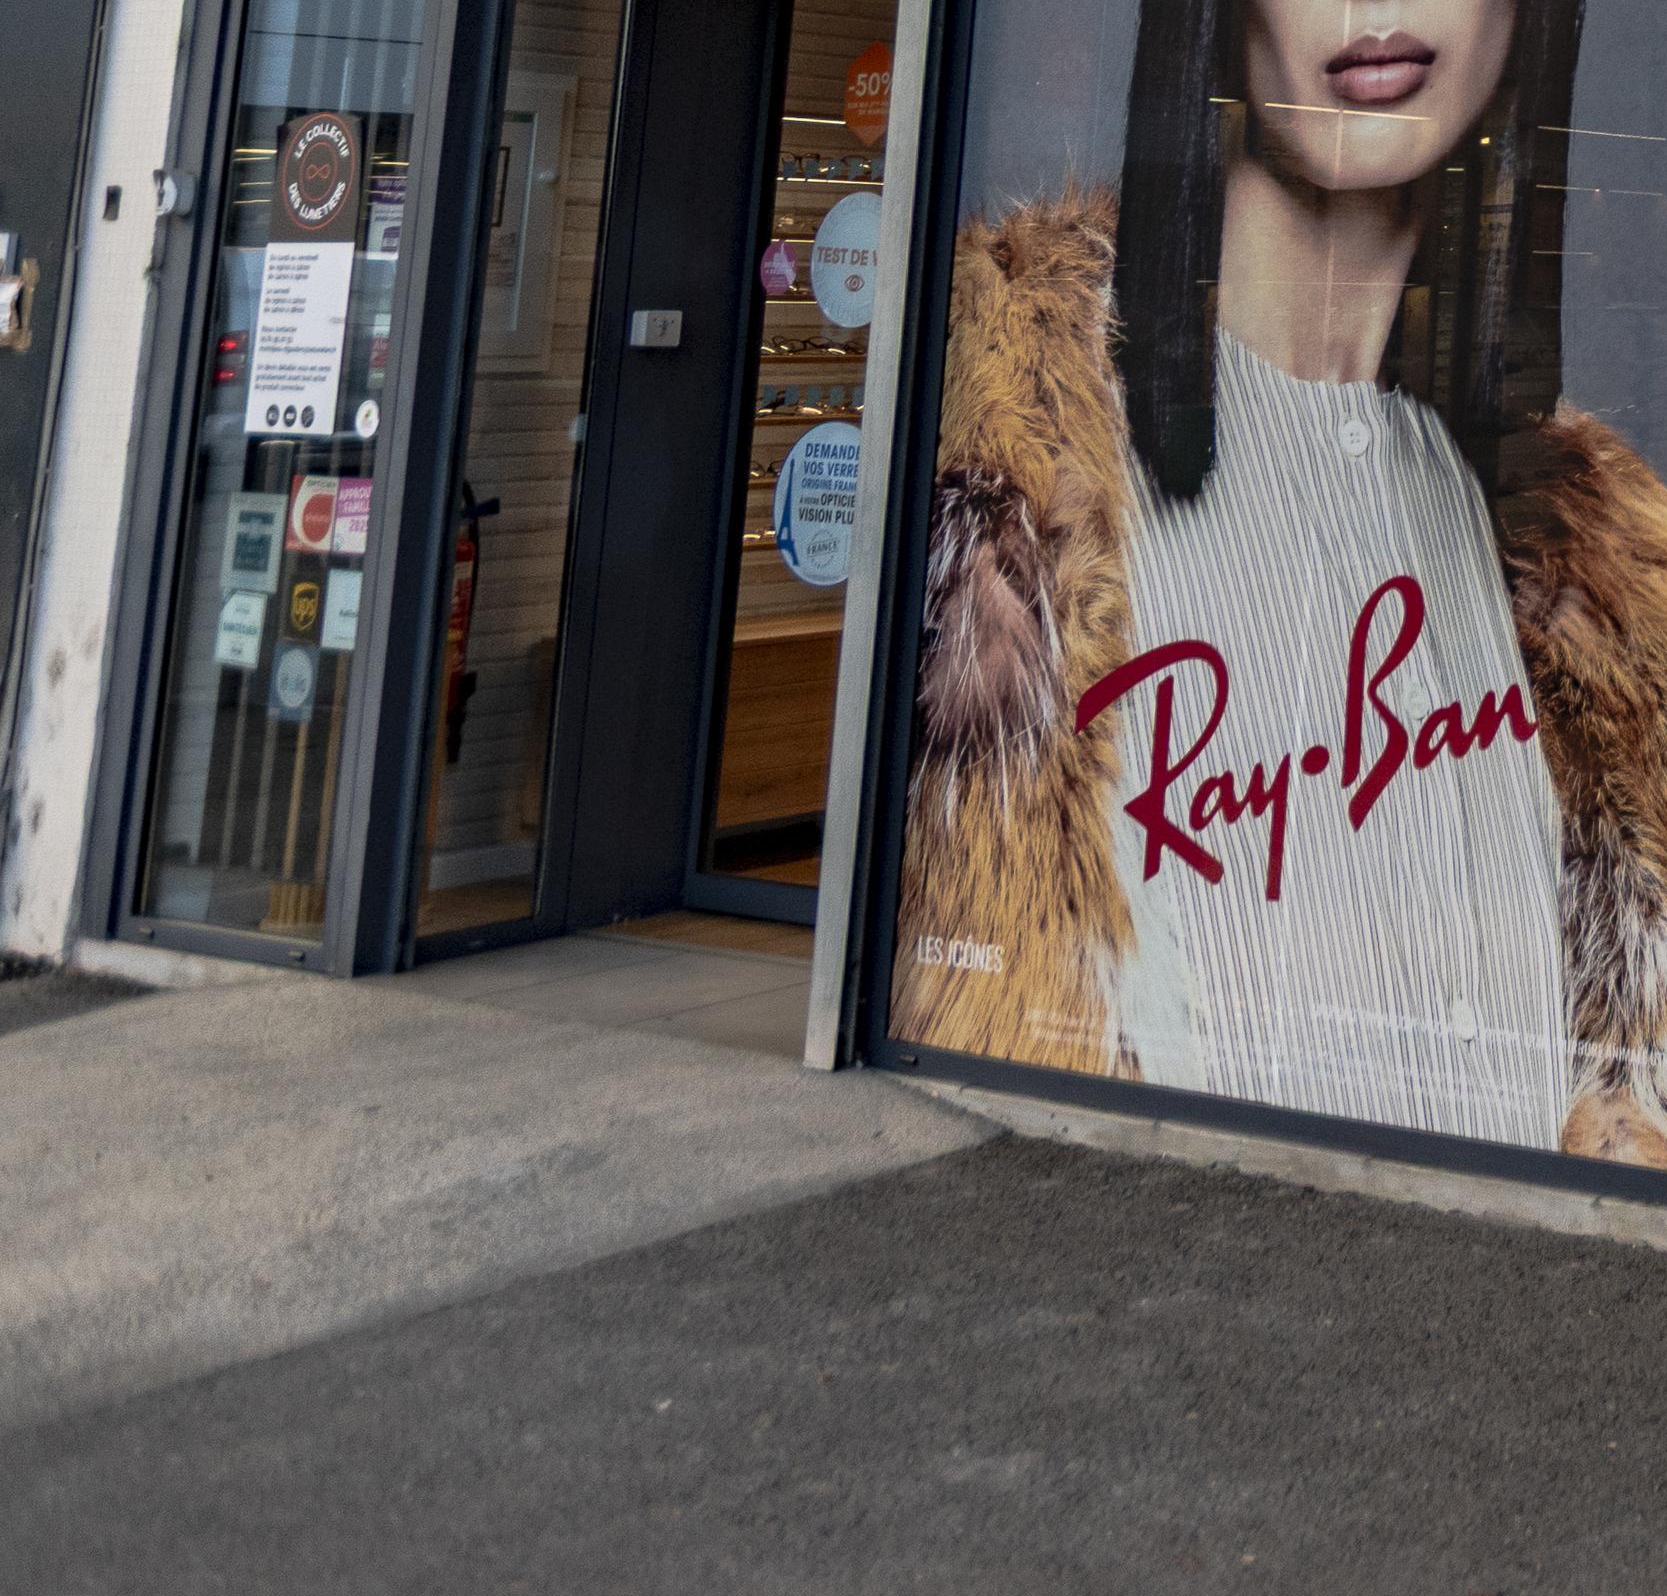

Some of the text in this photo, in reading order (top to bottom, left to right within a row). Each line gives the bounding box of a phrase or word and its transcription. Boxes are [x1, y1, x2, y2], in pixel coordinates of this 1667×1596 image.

[294, 123, 350, 159] LE COLLECTIF
[817, 246, 869, 266] TEST DE
[803, 461, 859, 478] VOS VERRE
[801, 477, 832, 490] ORIGINE
[820, 493, 855, 508] OPTICIE
[799, 507, 855, 525] VISION PLU
[918, 932, 1005, 973] LES ICÔNES
